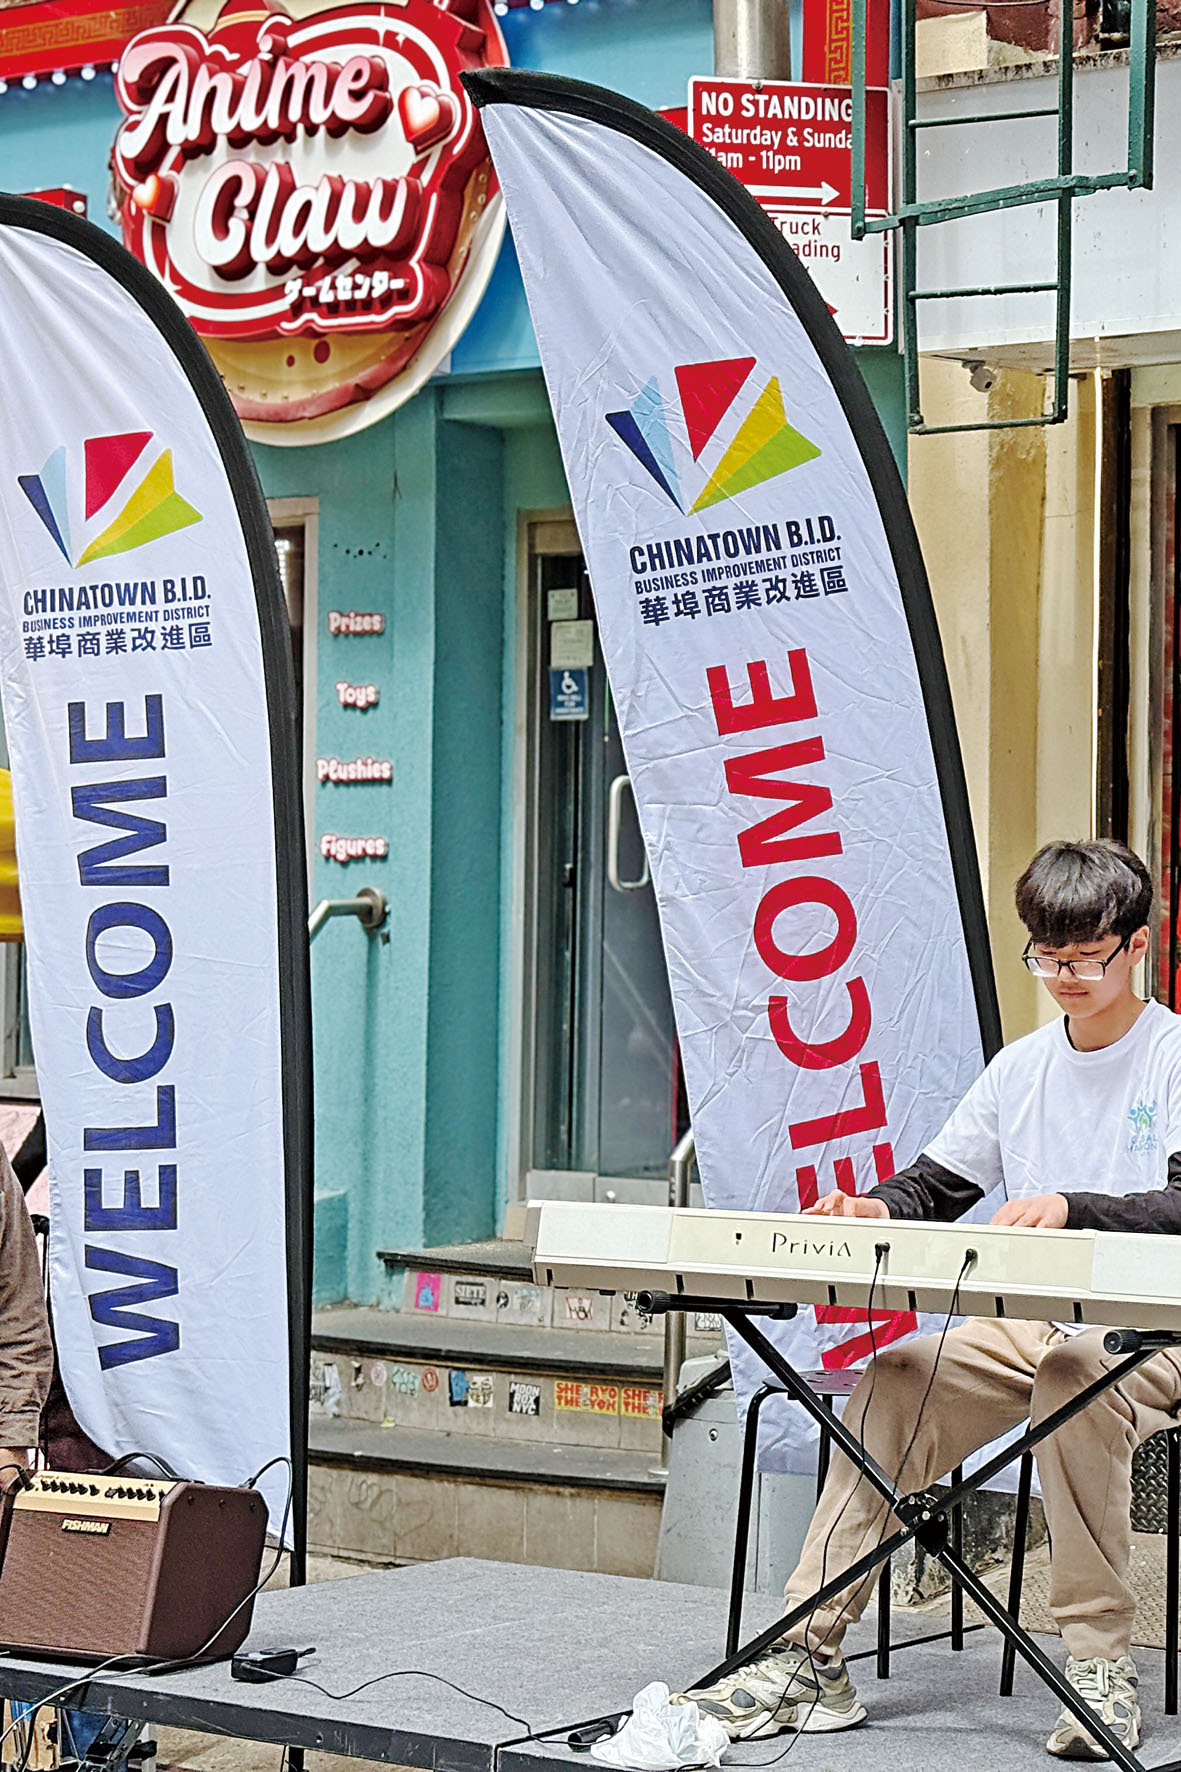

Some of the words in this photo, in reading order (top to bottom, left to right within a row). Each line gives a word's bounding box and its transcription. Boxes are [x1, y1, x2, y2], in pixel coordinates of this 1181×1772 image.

[119, 34, 391, 159] Anime
[701, 91, 734, 116] NO
[741, 94, 852, 122] STANDING
[702, 123, 782, 148] Saturday
[786, 128, 799, 147] &
[803, 128, 852, 149] Sunda
[705, 148, 743, 169] 1am
[760, 150, 801, 174] 11pm
[194, 160, 408, 265] Claw
[794, 243, 841, 262] ading
[629, 524, 782, 575] CHINATOWN
[786, 515, 842, 549] B.I.D.
[634, 571, 698, 595] BUSINESS
[701, 556, 788, 584] IMPROVEMENT
[791, 547, 842, 569] DISTRICT
[23, 580, 156, 616] CHINATOWN
[162, 576, 211, 604] B.I.D.
[639, 565, 848, 627] 華埠商業改進區
[22, 617, 75, 633] BUSINESS
[78, 610, 160, 628] IMPROVEMENT
[163, 605, 210, 622] DISTRICT
[328, 611, 384, 634] Prizes
[24, 622, 213, 662] 華埠商業改進區
[336, 681, 378, 708] Toys
[316, 757, 393, 782] Plushies
[67, 693, 181, 1371] WELCOME
[512, 1402, 536, 1415] NYC
[61, 1519, 110, 1534] FISHMAN
